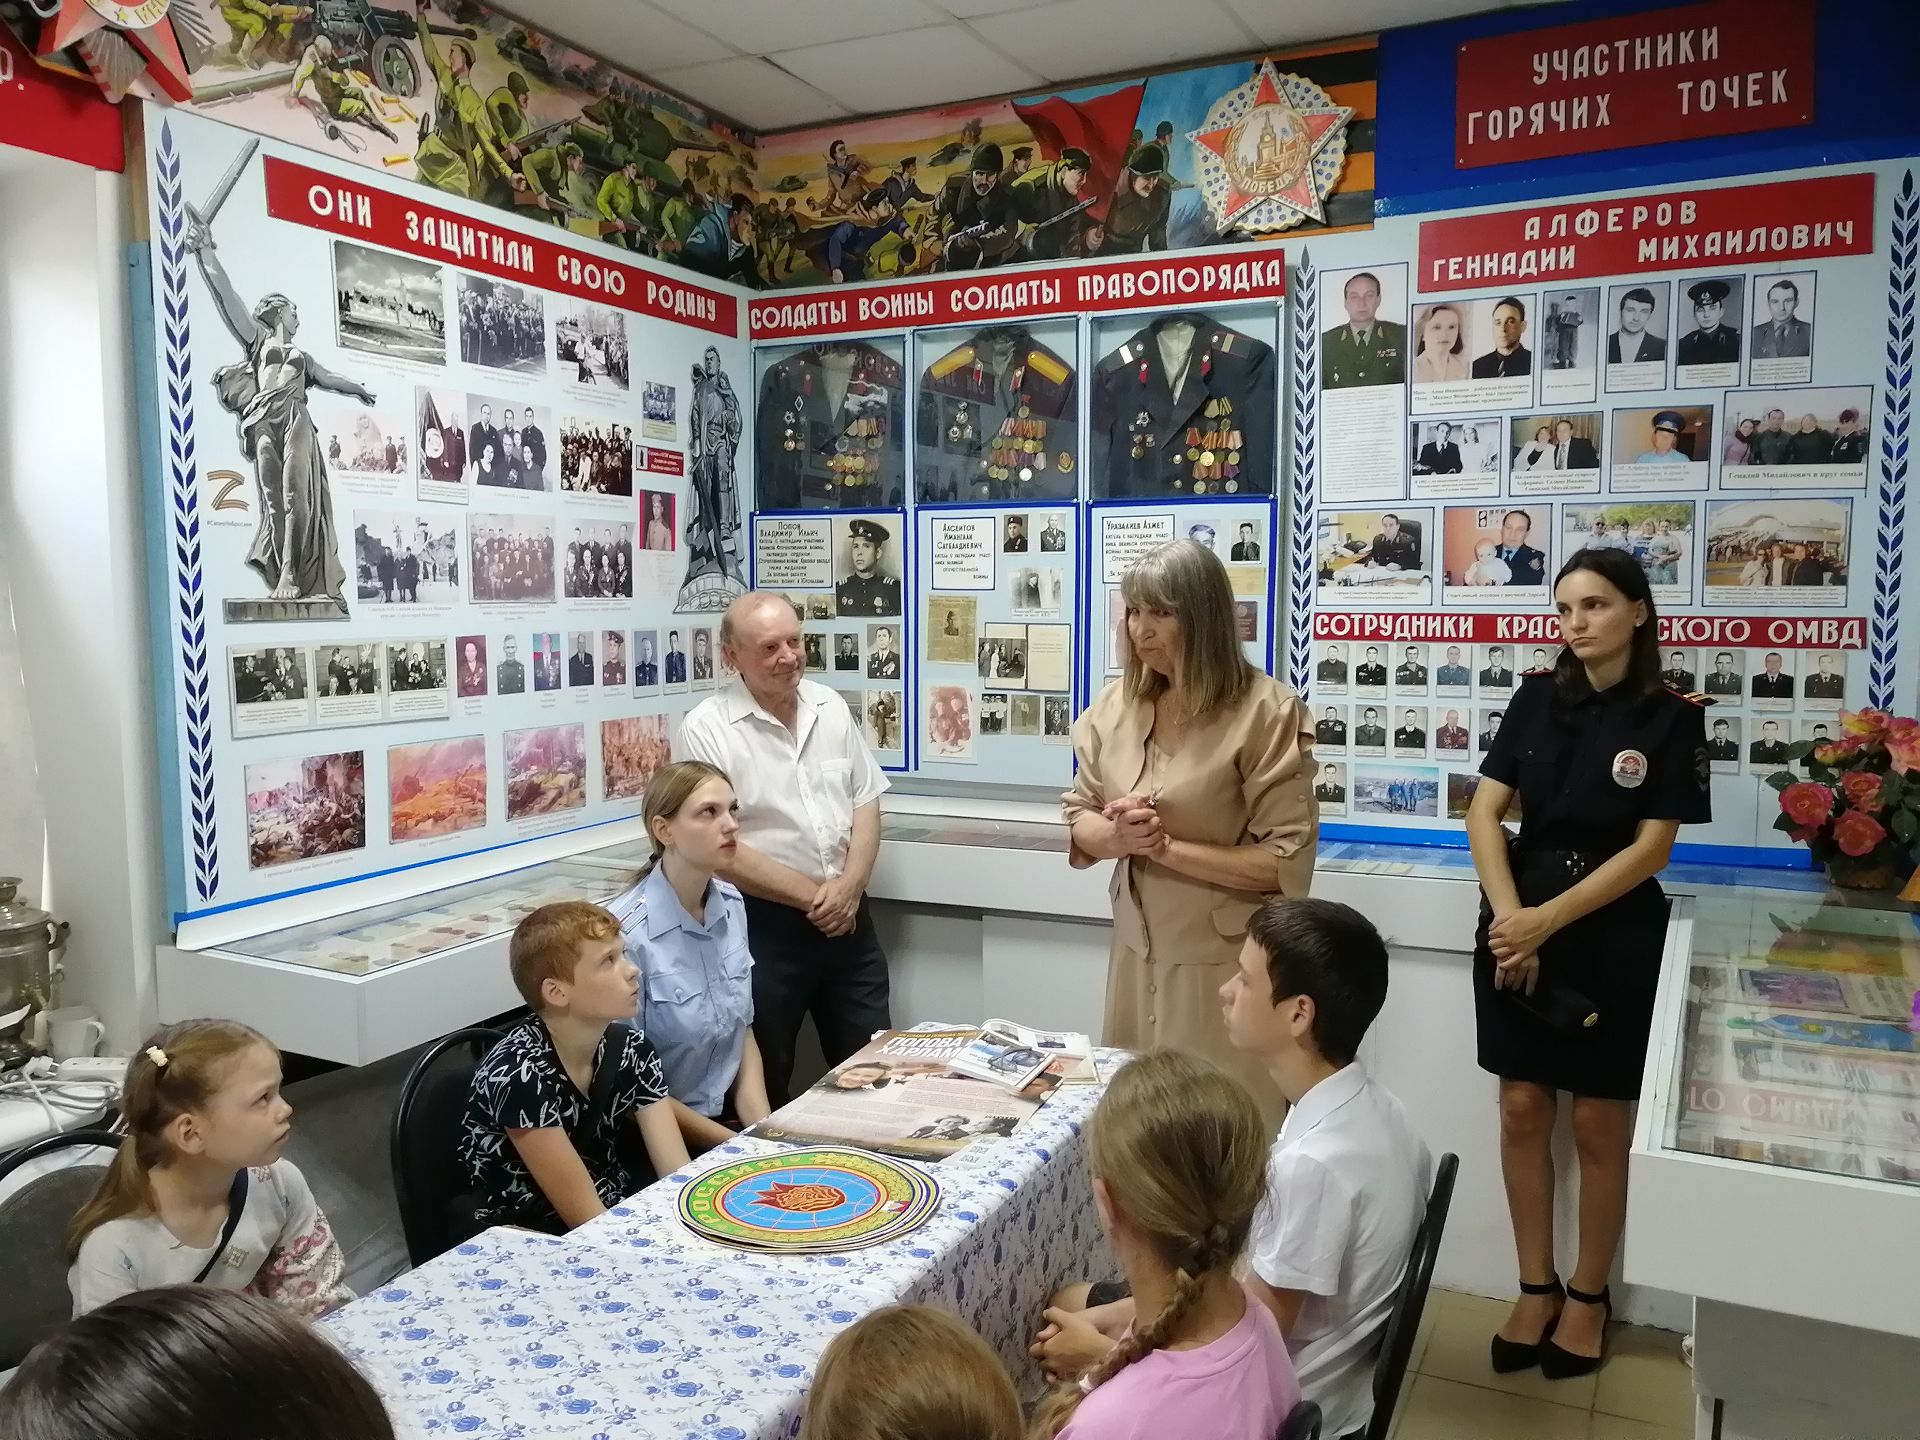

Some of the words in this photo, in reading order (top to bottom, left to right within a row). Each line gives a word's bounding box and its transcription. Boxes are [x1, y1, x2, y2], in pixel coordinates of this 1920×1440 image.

[1533, 28, 1718, 85] УЧАСТНИКИ
[1468, 93, 1610, 145] ГОРЯЧИХ
[1677, 70, 1787, 115] ТОЧЕК
[1241, 171, 1295, 192] ПОБЕДА
[1524, 200, 1697, 241] АЛФЕРОВ
[308, 186, 372, 229] ОНИ
[405, 212, 534, 273] ЗАЩИТИЛИ
[557, 255, 626, 296] СВОЮ
[647, 281, 717, 323] РОДИНУ
[1433, 245, 1576, 282] ГЕННАДИИ
[1638, 220, 1853, 263] МИХАИЛОВИЧ
[750, 300, 847, 331] СОЛДАТЫ
[858, 290, 934, 321] ВОИНЫ
[950, 279, 1061, 313] СОЛДАТЫ
[1077, 259, 1280, 301] ПРАВОПОРЯДКА
[1315, 614, 1474, 640] СОТРУДНИКИ
[1767, 619, 1863, 649] ОМВД
[876, 1045, 963, 1058] ХАРЛАМ
[886, 1036, 965, 1048] ПОПОВА
[692, 1159, 784, 1224] РОССИЯ
